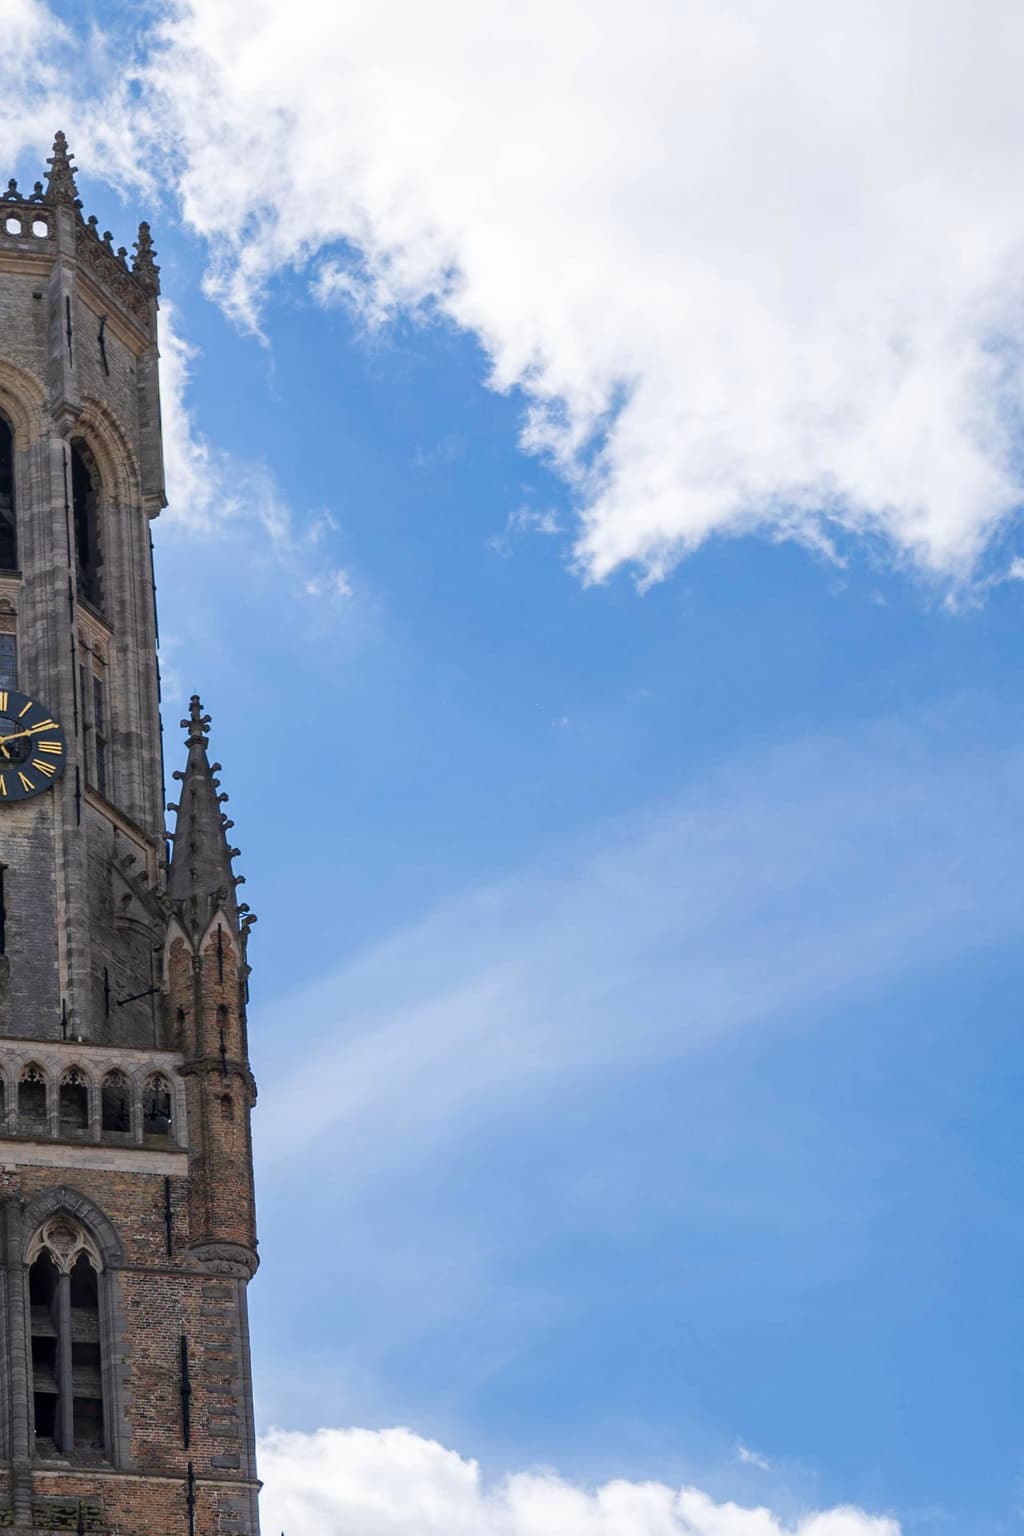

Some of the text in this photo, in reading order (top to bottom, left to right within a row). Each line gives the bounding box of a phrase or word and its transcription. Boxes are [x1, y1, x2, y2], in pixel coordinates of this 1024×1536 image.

[18, 702, 32, 717] I
[37, 741, 63, 755] III
[31, 758, 57, 778] IV
[17, 771, 36, 792] V
